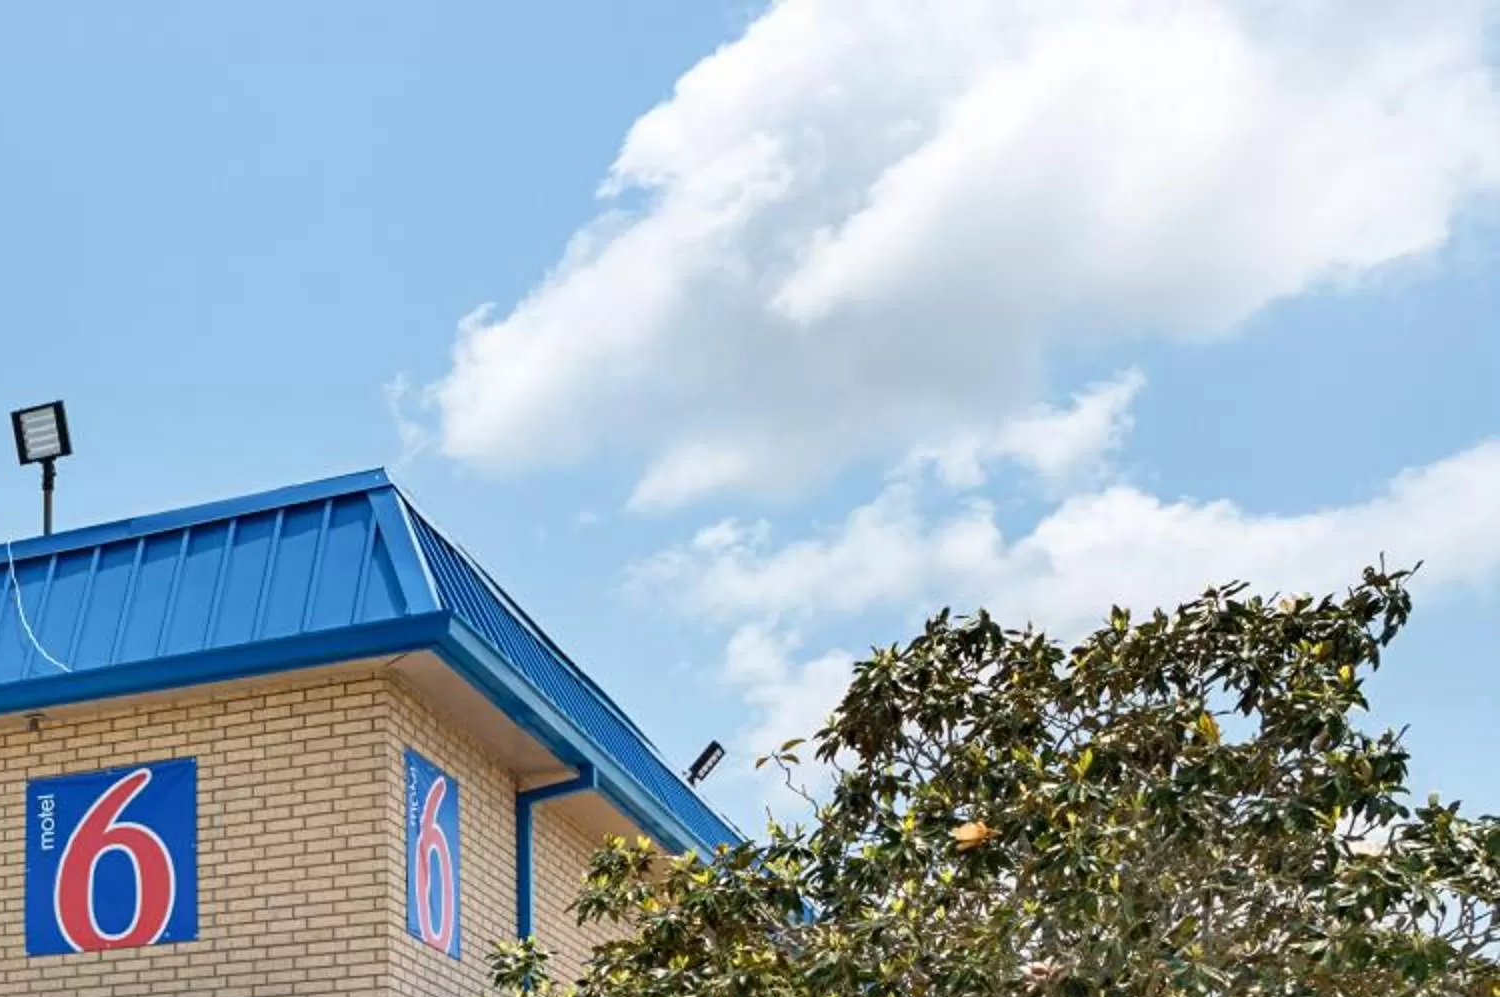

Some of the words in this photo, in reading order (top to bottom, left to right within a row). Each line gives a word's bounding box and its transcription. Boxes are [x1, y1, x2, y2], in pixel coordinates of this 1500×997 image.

[37, 793, 55, 851] motel
[54, 768, 176, 952] 6
[415, 776, 455, 954] 6
